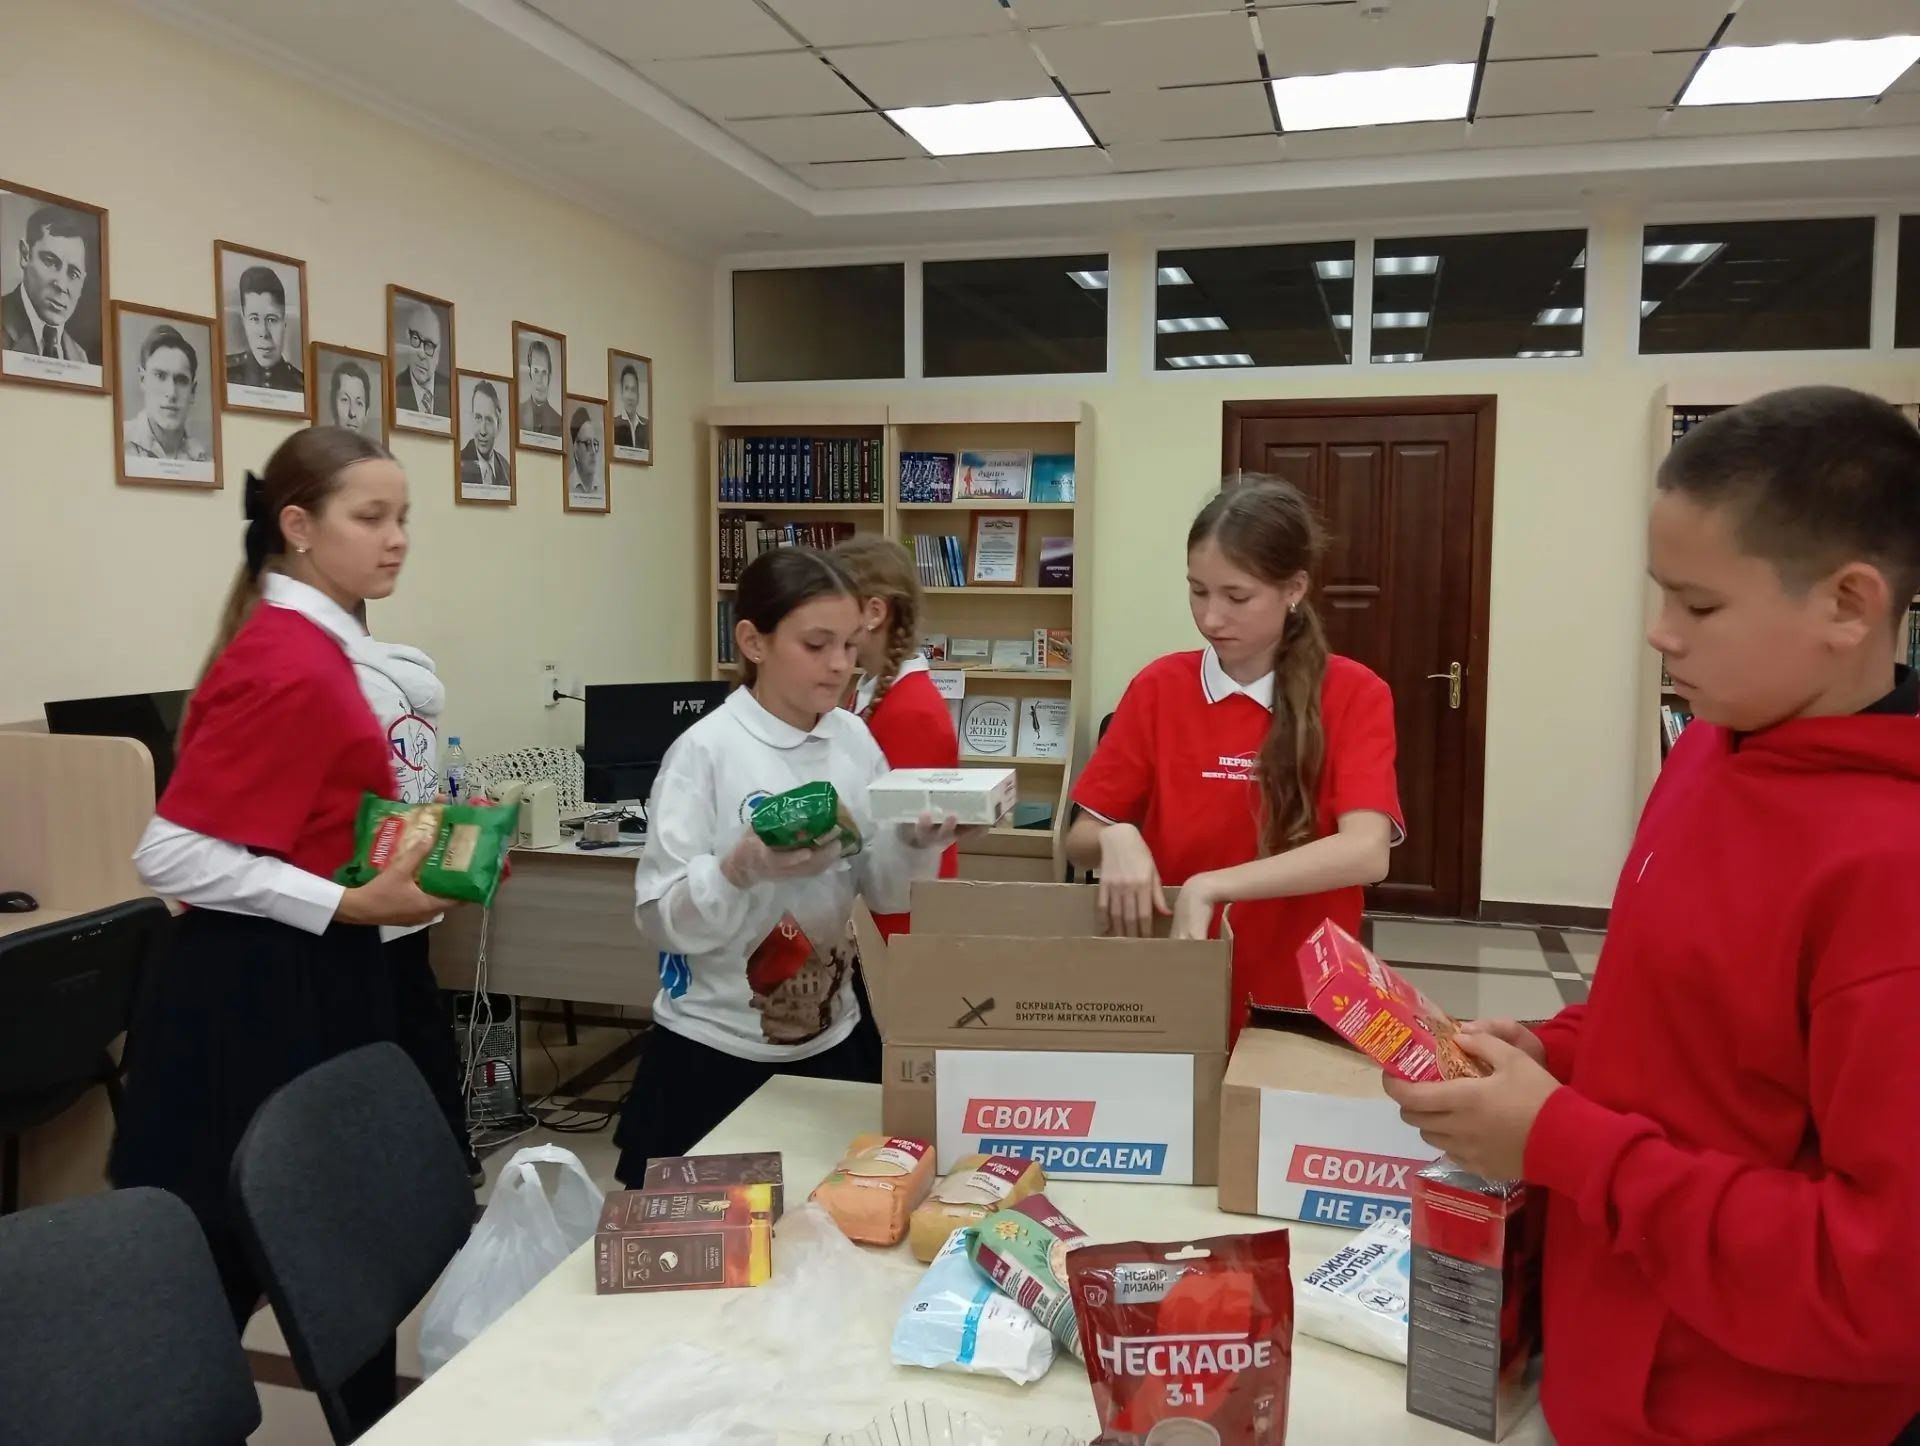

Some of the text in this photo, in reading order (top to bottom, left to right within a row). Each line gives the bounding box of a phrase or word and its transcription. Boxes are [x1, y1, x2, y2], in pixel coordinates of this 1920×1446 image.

[971, 717, 1008, 726] НАША
[969, 726, 1008, 736] ЖИЗНЬ
[1015, 1001, 1143, 1012] ВСКРЫВАТЬ ОСТОРОЖНО!
[1015, 1013, 1156, 1024] ВНУТРИ МЯГКАЯ УПАКОВКА!
[976, 1105, 1073, 1131] СВОИХ
[990, 1143, 1153, 1171] НЕ БРОСАЕМ
[1303, 1153, 1411, 1190] СВОИХ
[1315, 1197, 1354, 1222] НЕ
[1359, 1203, 1413, 1228] БРО
[1320, 1243, 1389, 1293] ПОЛОТЕНЦА
[1124, 1269, 1169, 1282] НОВЫЙ
[1123, 1281, 1164, 1294] ДИЗАЙН
[1088, 1291, 1096, 1300] 9
[1370, 1295, 1393, 1307] XL
